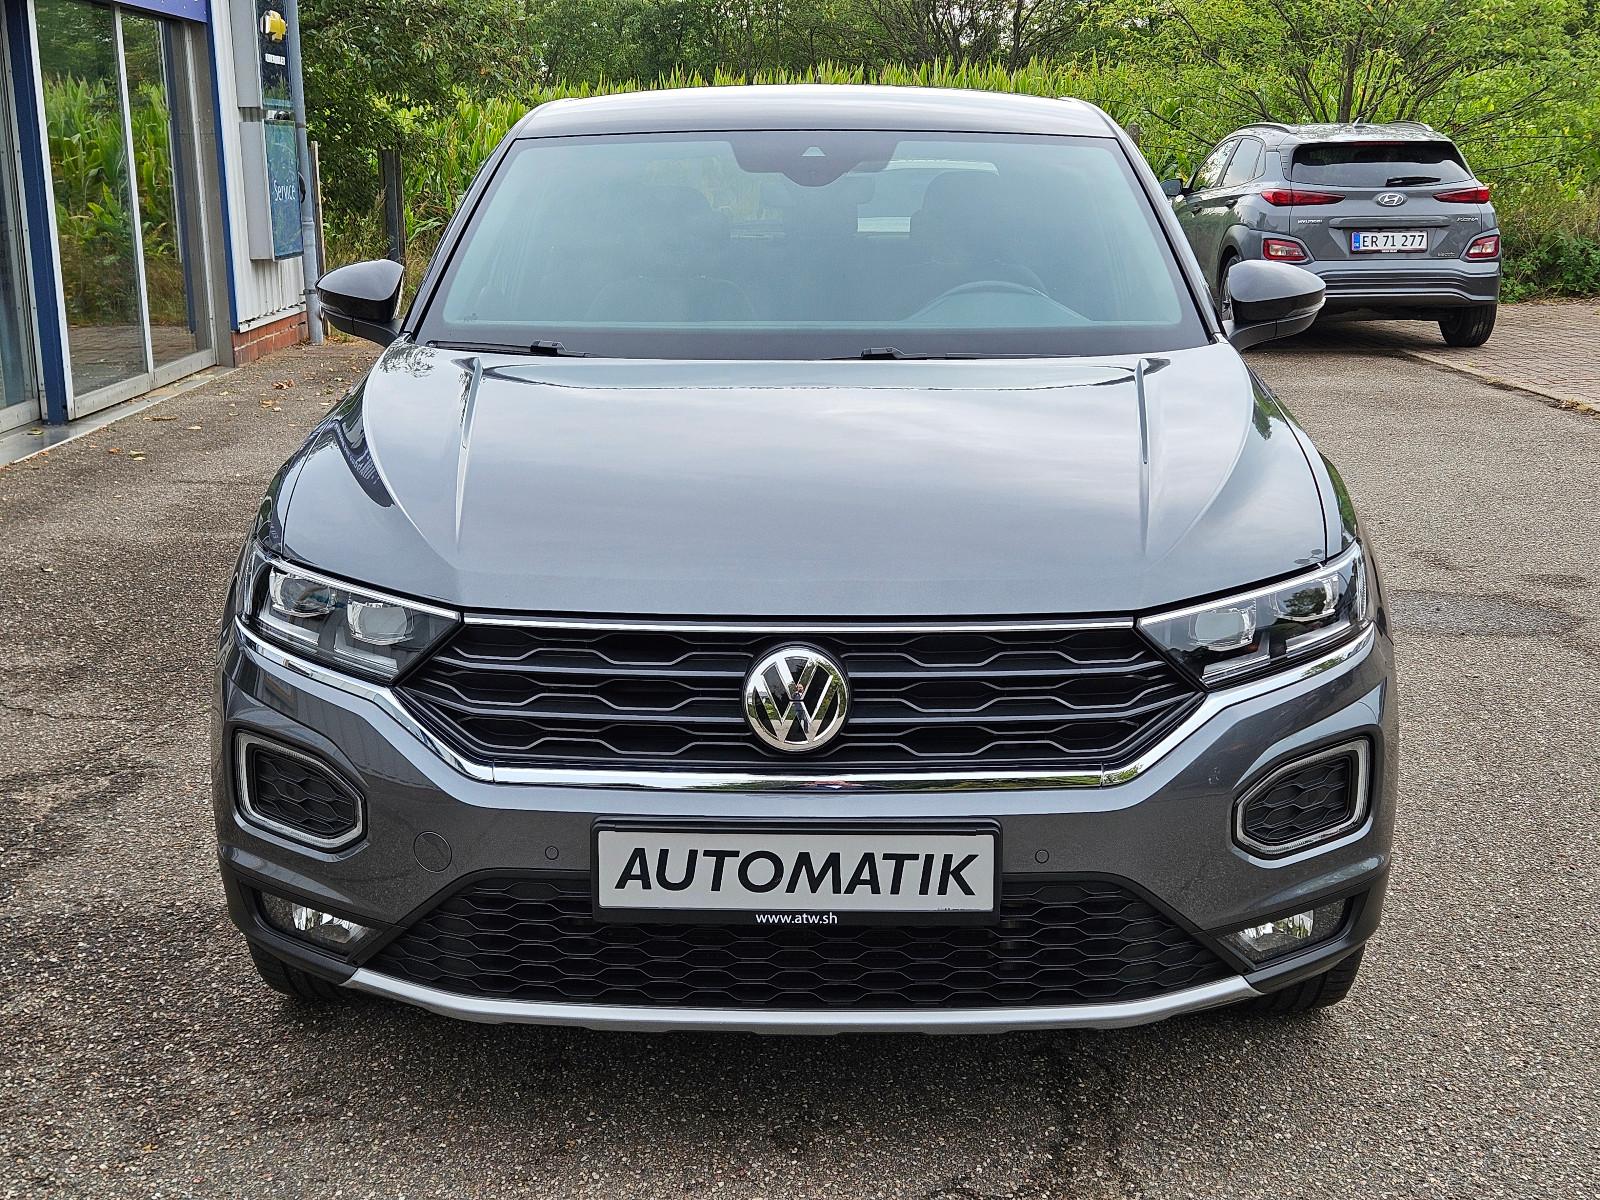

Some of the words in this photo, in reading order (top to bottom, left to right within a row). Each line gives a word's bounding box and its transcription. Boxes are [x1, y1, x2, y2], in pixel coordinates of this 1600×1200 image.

[273, 179, 296, 201] Service
[1362, 235, 1379, 248] ER
[1382, 235, 1397, 247] 71
[1401, 234, 1425, 247] 277
[614, 847, 980, 896] AUTOMATIK
[755, 912, 838, 924] www.atw.sh
